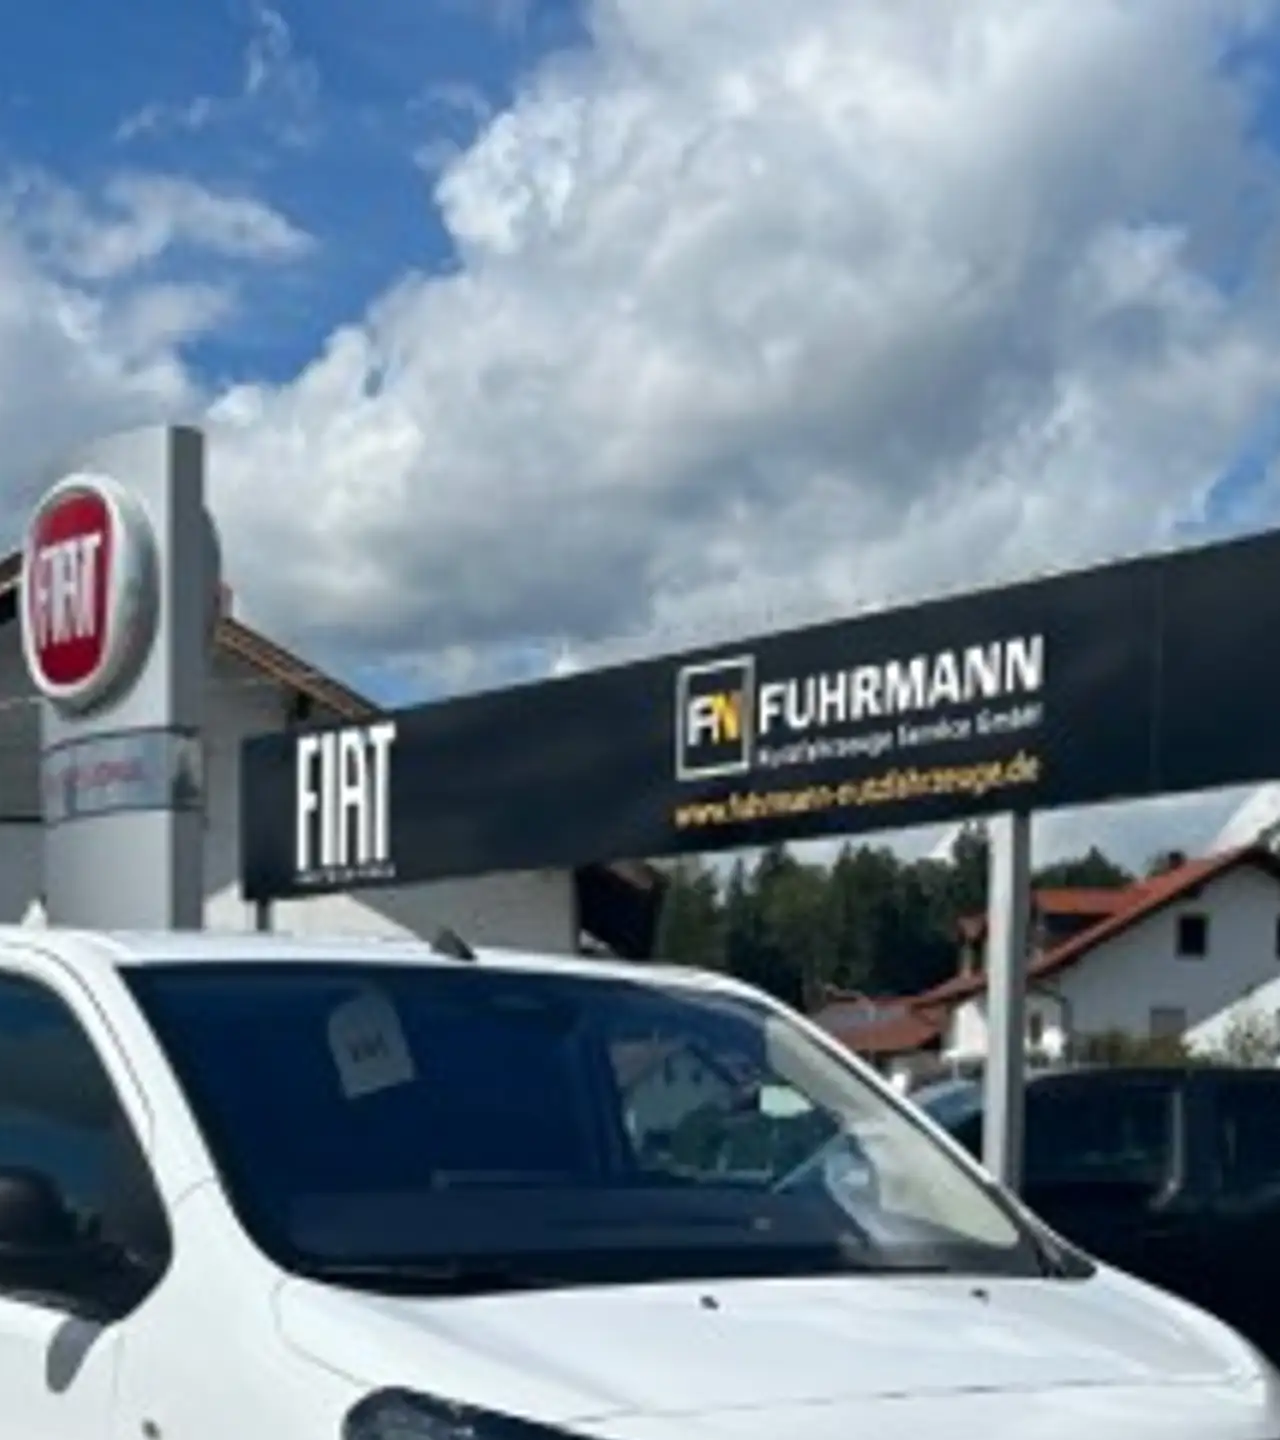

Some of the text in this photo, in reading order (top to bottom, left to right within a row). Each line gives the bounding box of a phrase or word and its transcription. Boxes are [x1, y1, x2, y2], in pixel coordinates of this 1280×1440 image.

[37, 535, 99, 646] FIAT
[760, 636, 1043, 732] FUHRMANN
[296, 722, 397, 872] FIAT
